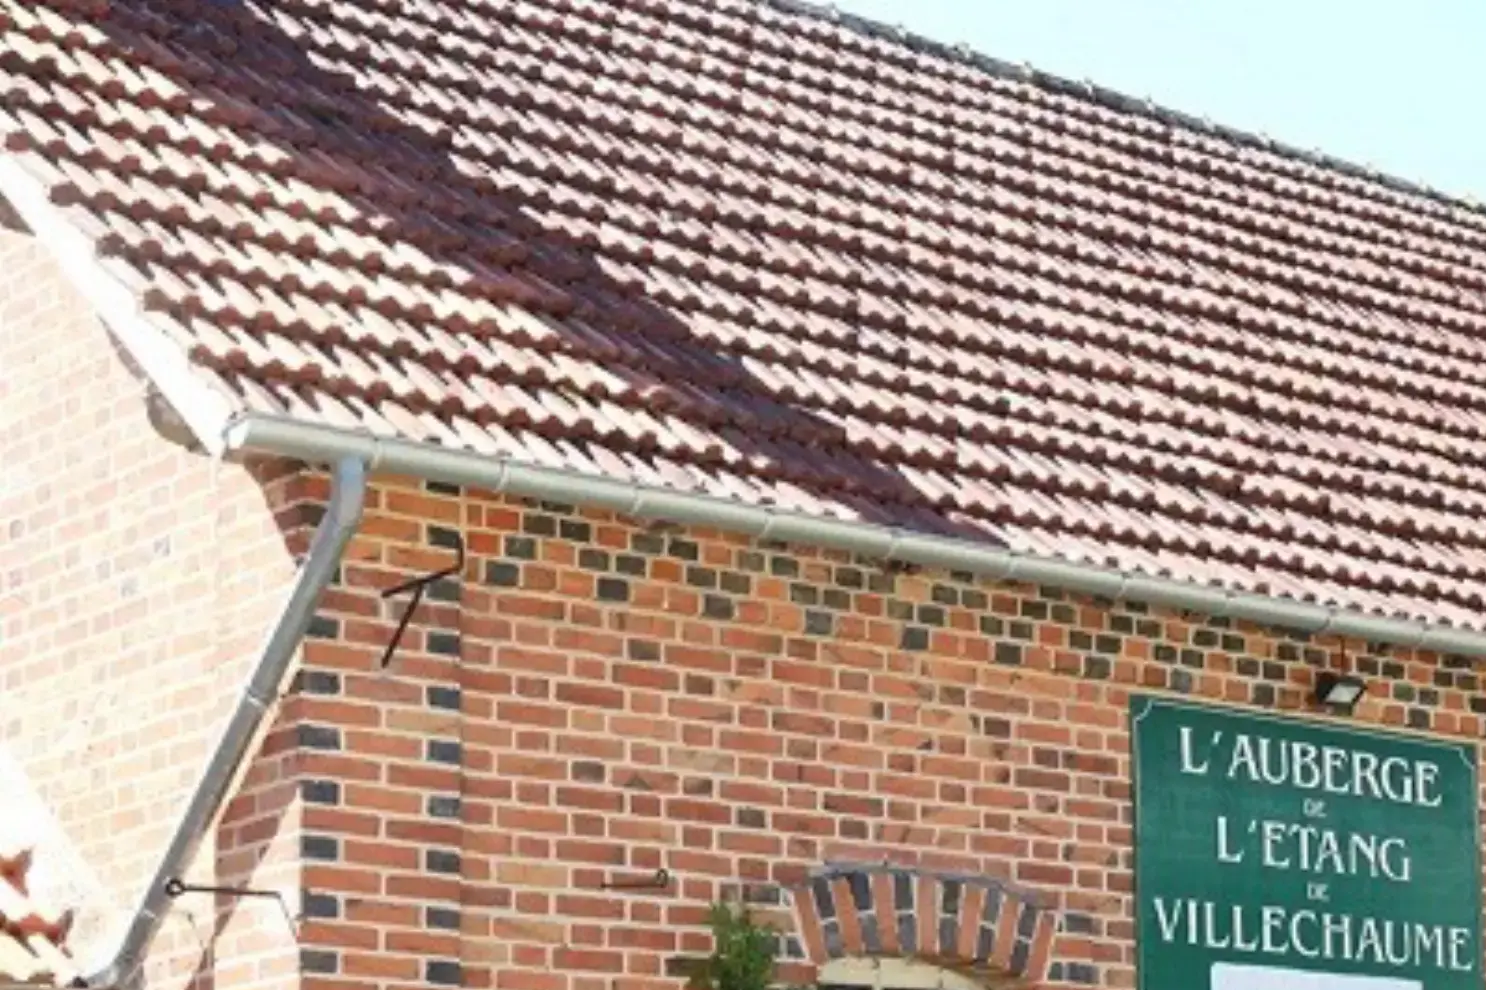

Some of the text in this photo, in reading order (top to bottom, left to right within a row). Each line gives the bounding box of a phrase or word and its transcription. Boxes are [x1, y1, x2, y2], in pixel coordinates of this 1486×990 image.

[1178, 726, 1442, 807] L'AUBERGE
[1303, 798, 1327, 818] DE
[1217, 816, 1411, 881] L'ETANG
[1307, 882, 1329, 901] DE
[1153, 897, 1473, 971] VILLECHAUME
